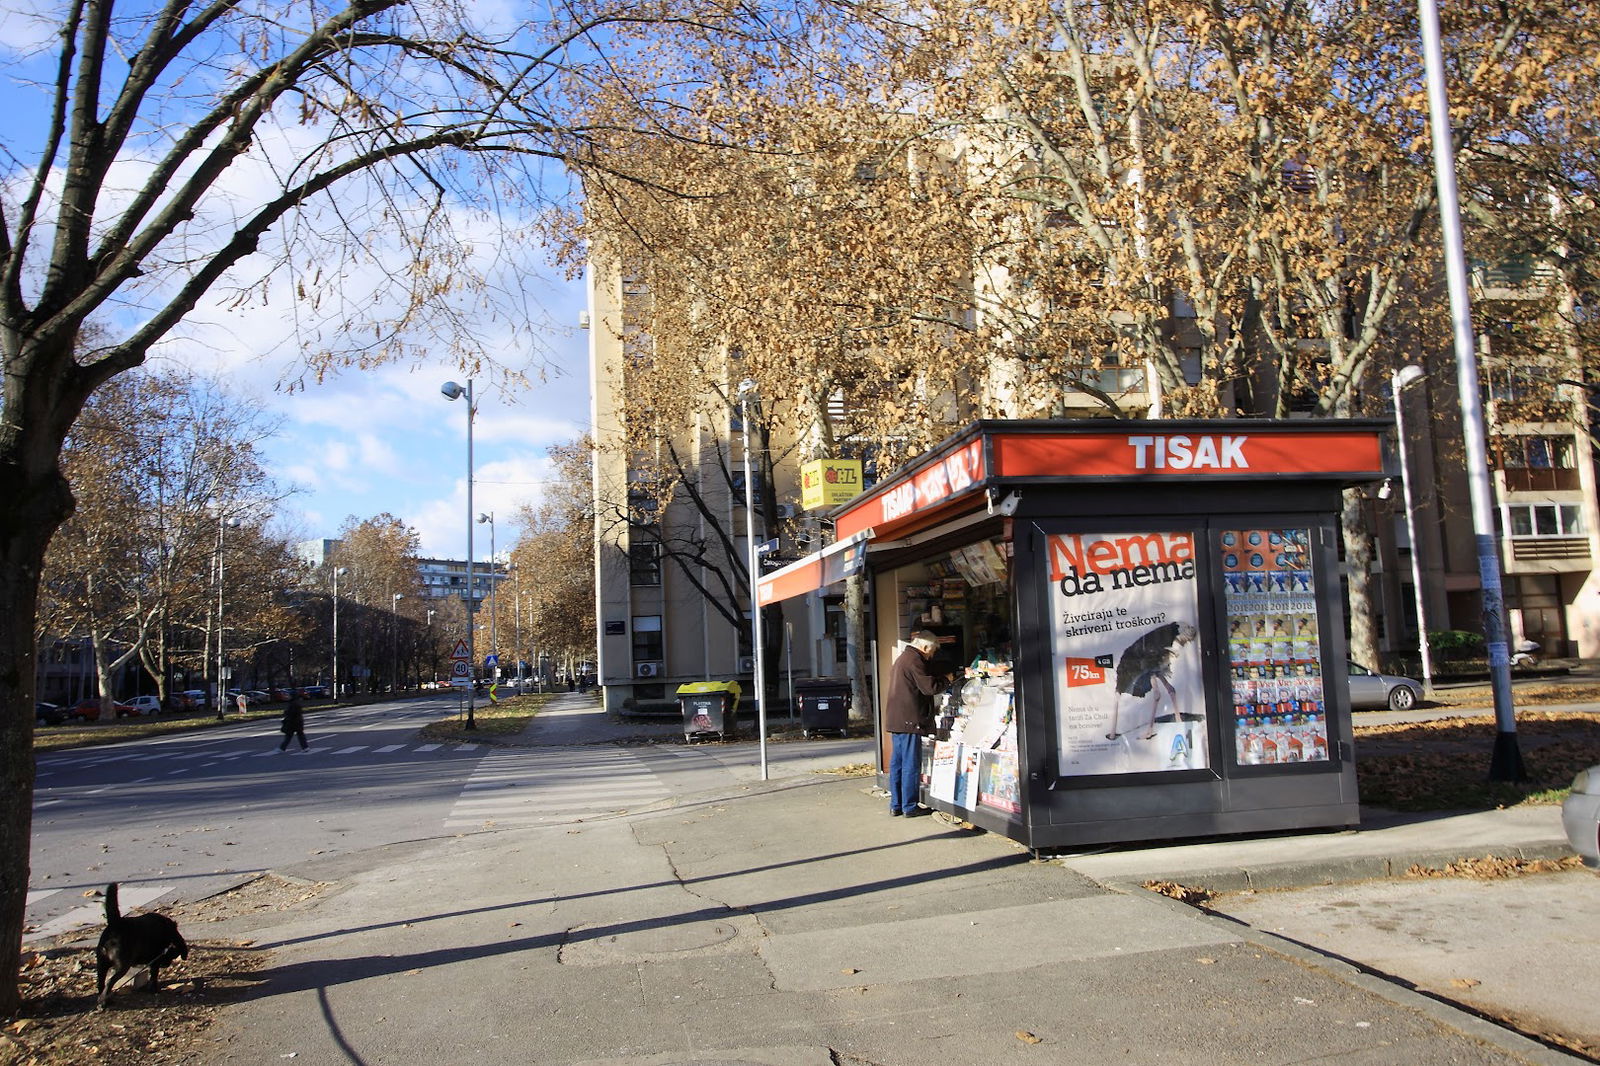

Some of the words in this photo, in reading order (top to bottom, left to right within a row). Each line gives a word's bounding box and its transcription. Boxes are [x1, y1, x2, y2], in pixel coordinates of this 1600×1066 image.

[1128, 435, 1249, 470] TISAK
[1047, 532, 1194, 582] Nema
[1060, 565, 1104, 598] da
[1110, 558, 1195, 590] nema
[1063, 608, 1113, 625] Živciraju
[1115, 606, 1128, 617] te
[1065, 622, 1113, 638] skriveni
[1115, 612, 1166, 629] troškovi?
[456, 664, 466, 673] 40
[1170, 729, 1193, 761] A1
